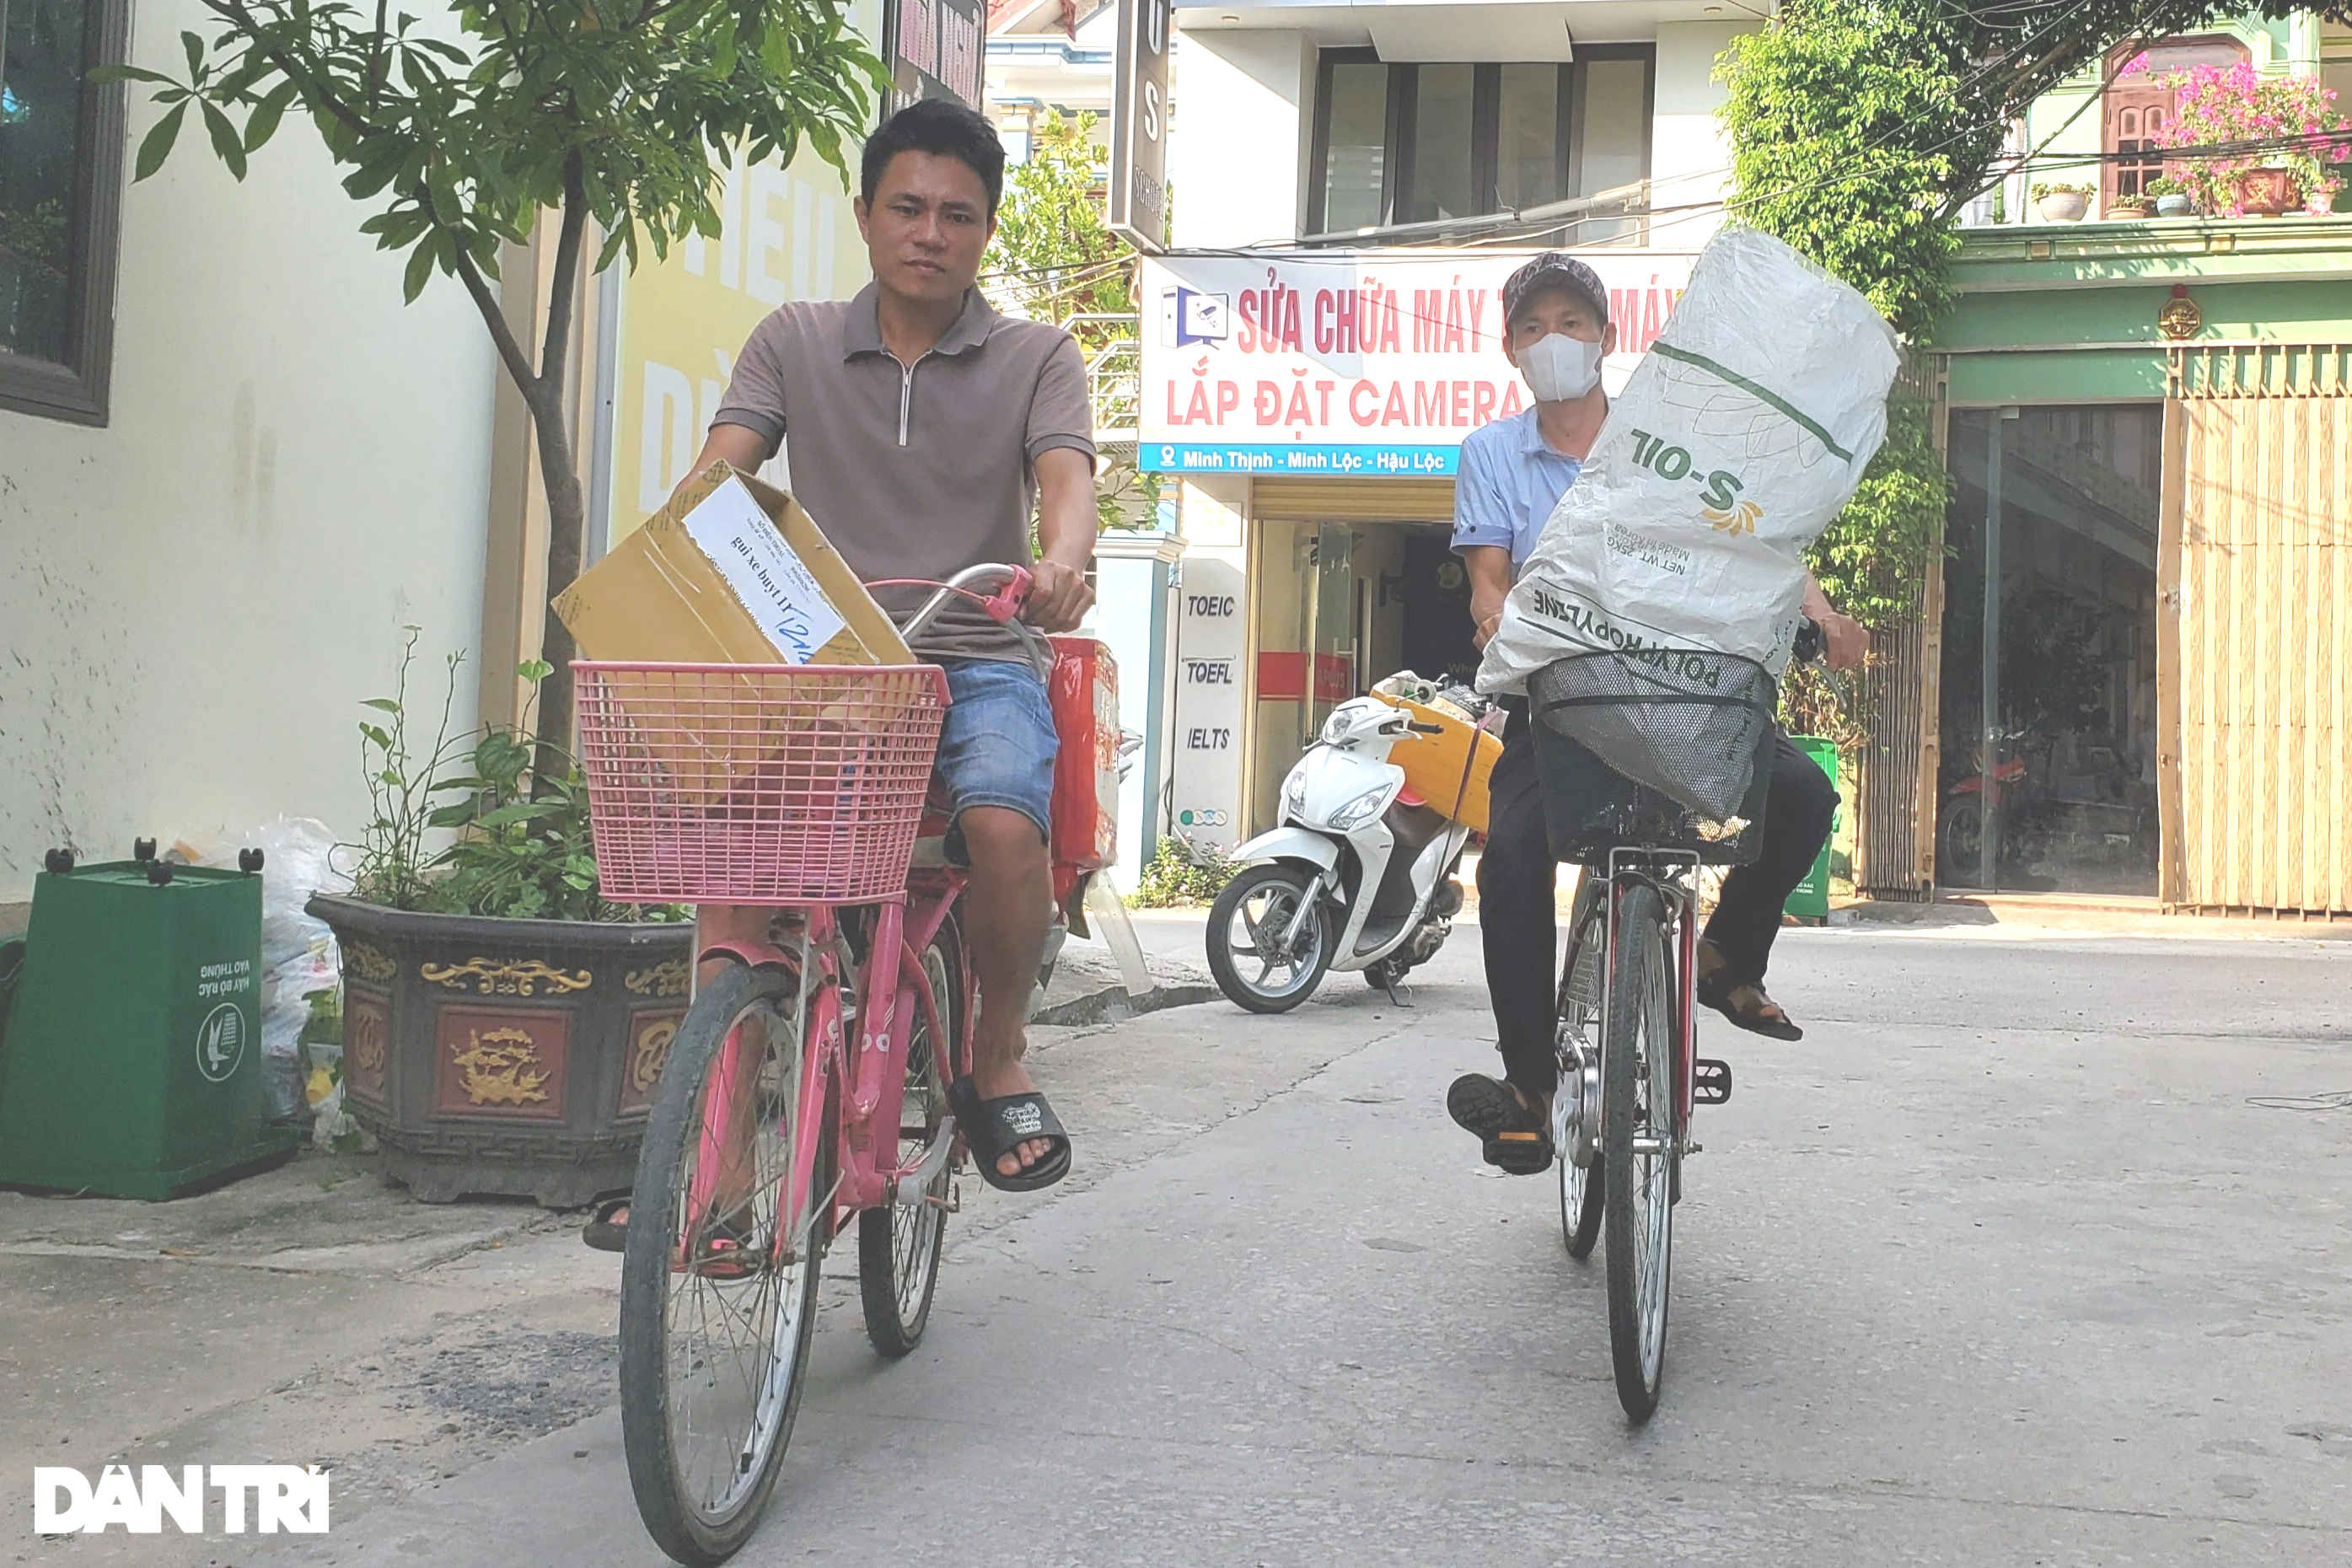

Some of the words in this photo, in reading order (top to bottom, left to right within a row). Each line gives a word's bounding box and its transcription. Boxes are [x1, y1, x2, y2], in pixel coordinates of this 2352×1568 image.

[1238, 266, 1304, 354] SỬA
[1314, 276, 1402, 354] CHỮA
[1413, 275, 1487, 353] MÁY
[1167, 355, 1240, 426] LẮP
[1254, 368, 1336, 440] ĐẶT
[1349, 379, 1524, 427] CAMERA
[1184, 451, 1222, 468] Minh
[1227, 451, 1273, 471] Thịnh
[1288, 452, 1327, 468] Minh
[1332, 452, 1362, 472] Lộc
[1377, 452, 1410, 472] Hậu
[1414, 452, 1444, 473] Lộc
[1630, 428, 1744, 511] S-OIL
[1607, 535, 1634, 557] 25KG
[730, 536, 753, 556] gui
[746, 555, 760, 572] xe
[757, 568, 781, 598] buyt
[1660, 559, 1685, 576] NET
[1188, 595, 1235, 617] TOEIC
[1187, 662, 1232, 685] TOEFL
[1187, 728, 1230, 749] IELTS
